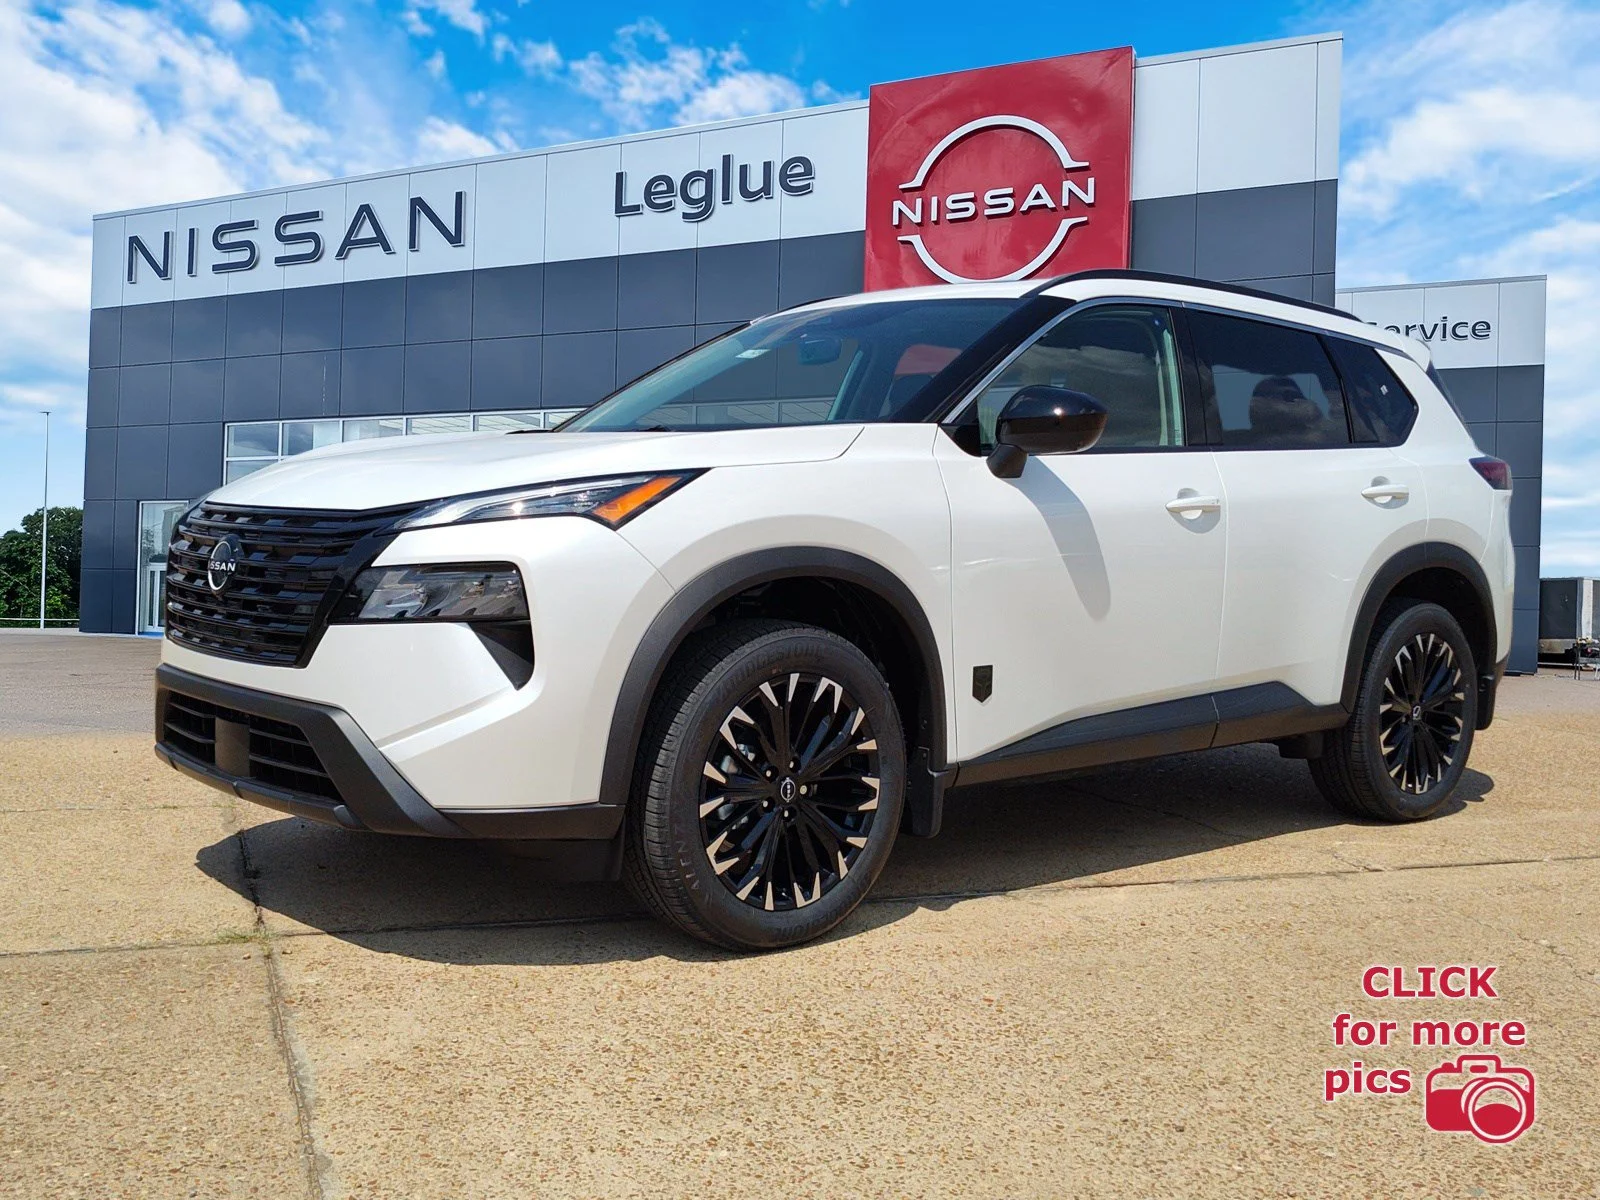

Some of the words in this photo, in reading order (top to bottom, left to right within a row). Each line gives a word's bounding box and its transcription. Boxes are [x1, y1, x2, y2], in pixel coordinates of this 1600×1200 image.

[613, 152, 815, 223] Leglue
[892, 177, 1095, 228] NISSAN
[126, 190, 466, 284] NISSAN
[1366, 315, 1492, 342] rvice
[208, 561, 236, 572] SSAN
